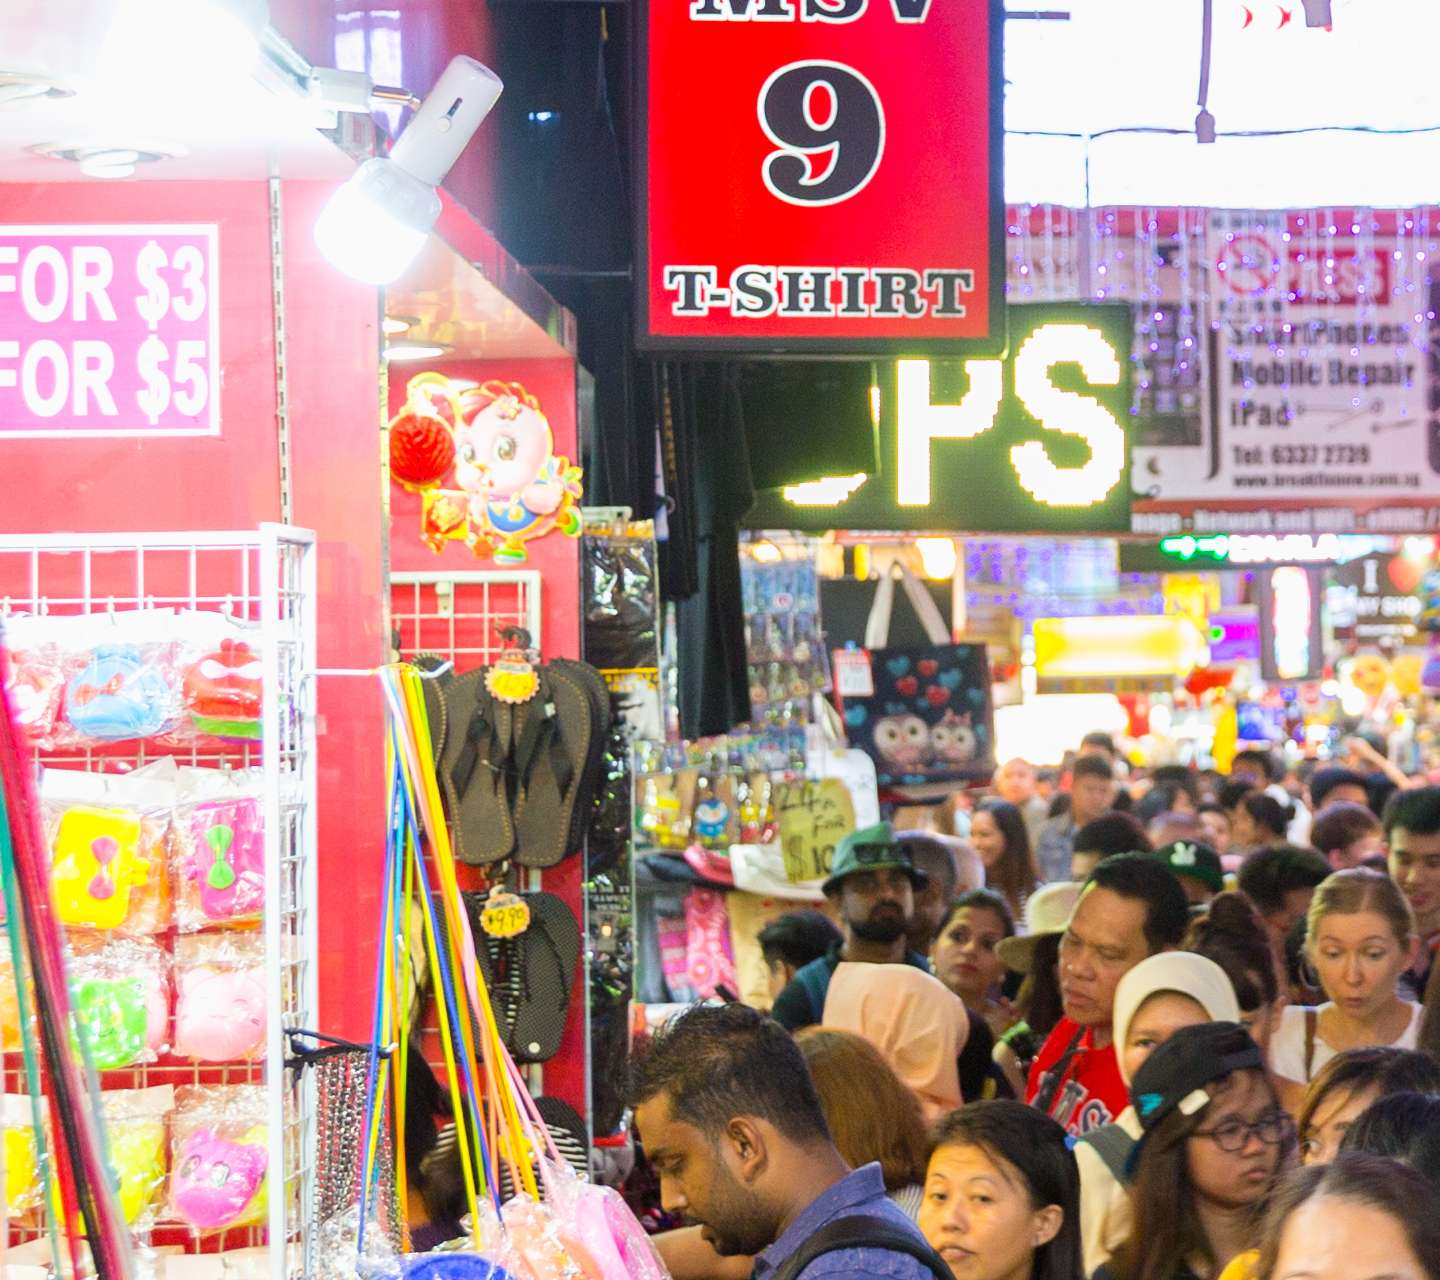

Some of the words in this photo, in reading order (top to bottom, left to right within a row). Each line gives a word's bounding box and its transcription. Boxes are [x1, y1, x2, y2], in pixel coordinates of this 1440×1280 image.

[757, 60, 886, 206] 9
[136, 241, 208, 330] $3
[663, 266, 973, 319] T-SHIRT
[136, 334, 208, 425] $5
[784, 323, 1126, 507] PS
